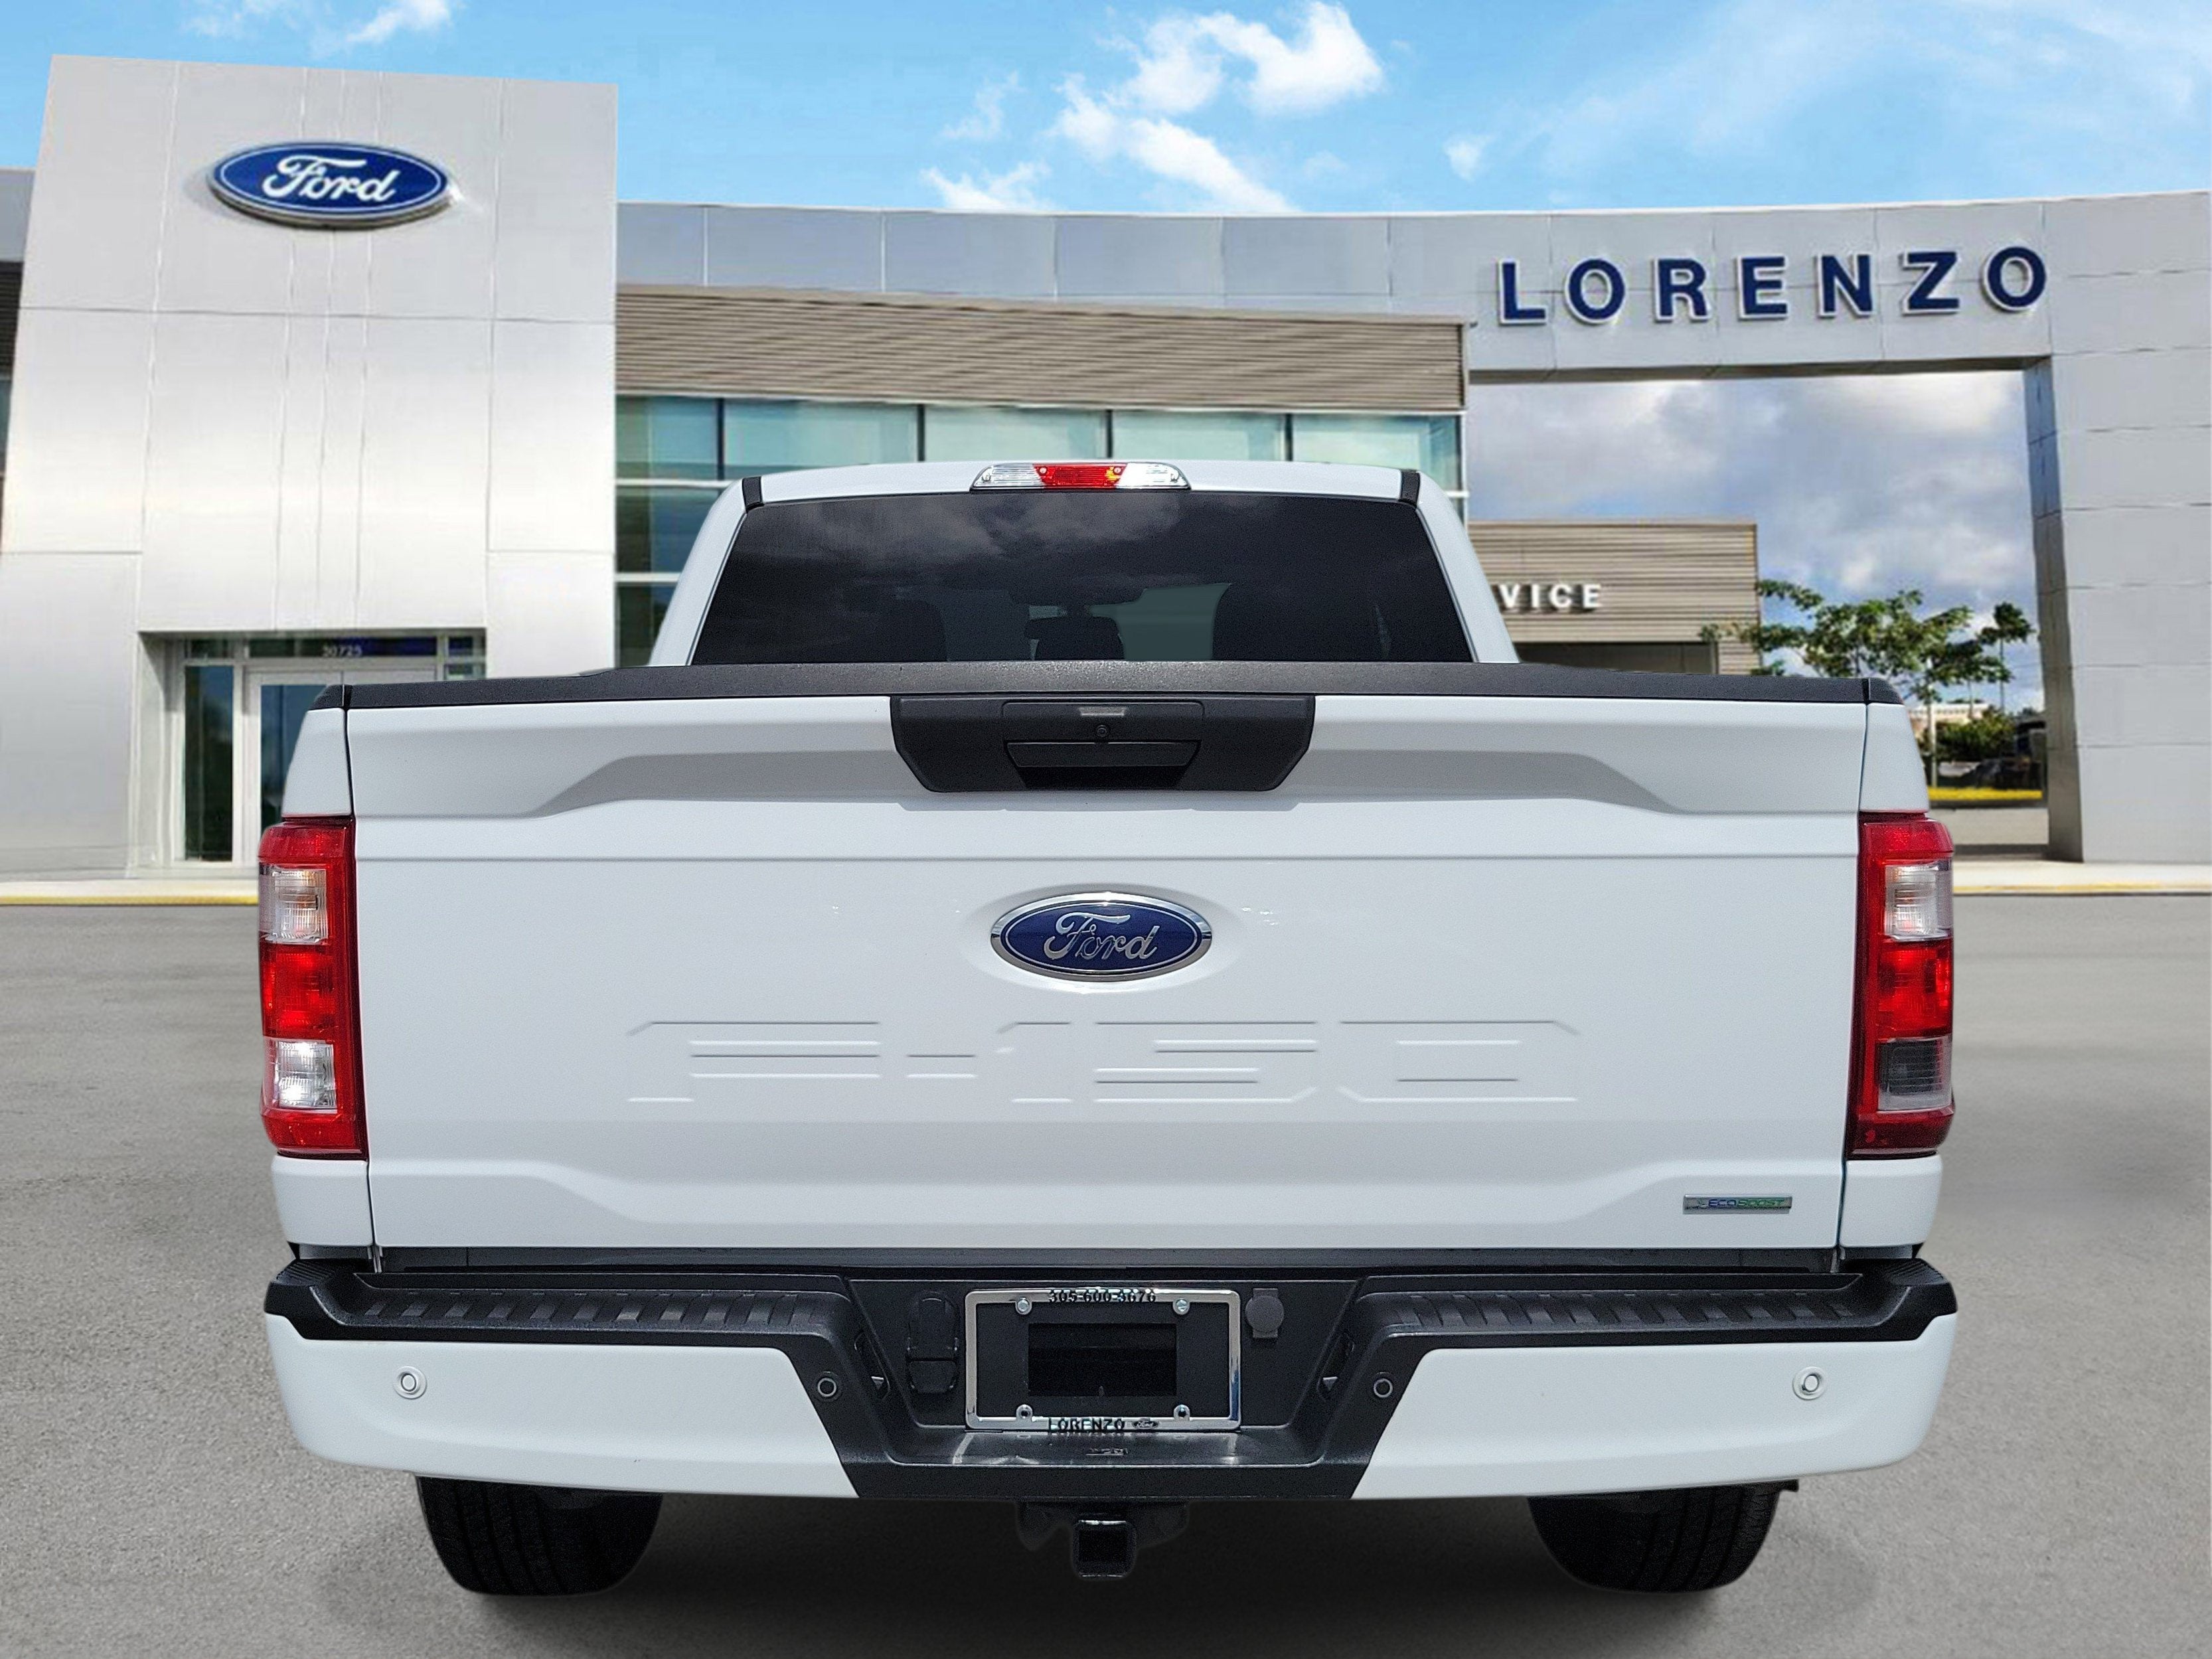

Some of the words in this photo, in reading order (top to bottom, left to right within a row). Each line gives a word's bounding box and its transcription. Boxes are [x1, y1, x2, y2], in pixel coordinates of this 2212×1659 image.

[262, 155, 400, 202] Ford
[1498, 246, 2047, 324] LORENZO
[1044, 911, 1160, 960] Ford
[1048, 1417, 1125, 1432] LORENZO
